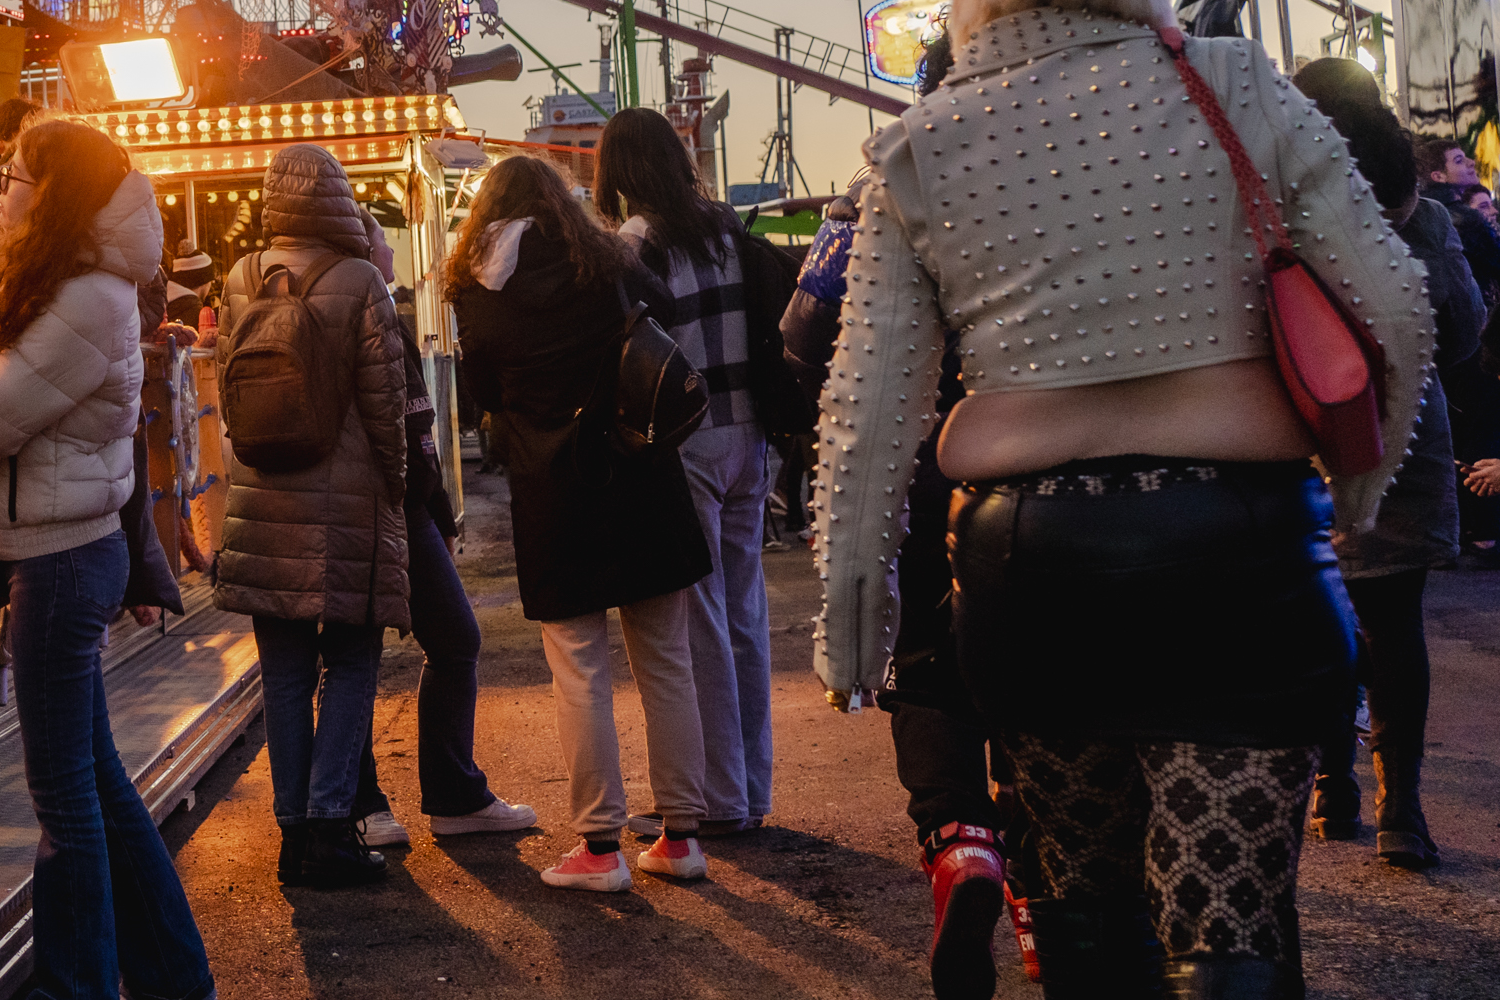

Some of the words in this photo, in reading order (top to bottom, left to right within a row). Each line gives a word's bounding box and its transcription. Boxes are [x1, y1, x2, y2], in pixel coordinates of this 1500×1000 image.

[965, 824, 987, 839] 33
[955, 846, 994, 864] EWING
[1018, 906, 1032, 923] 3
